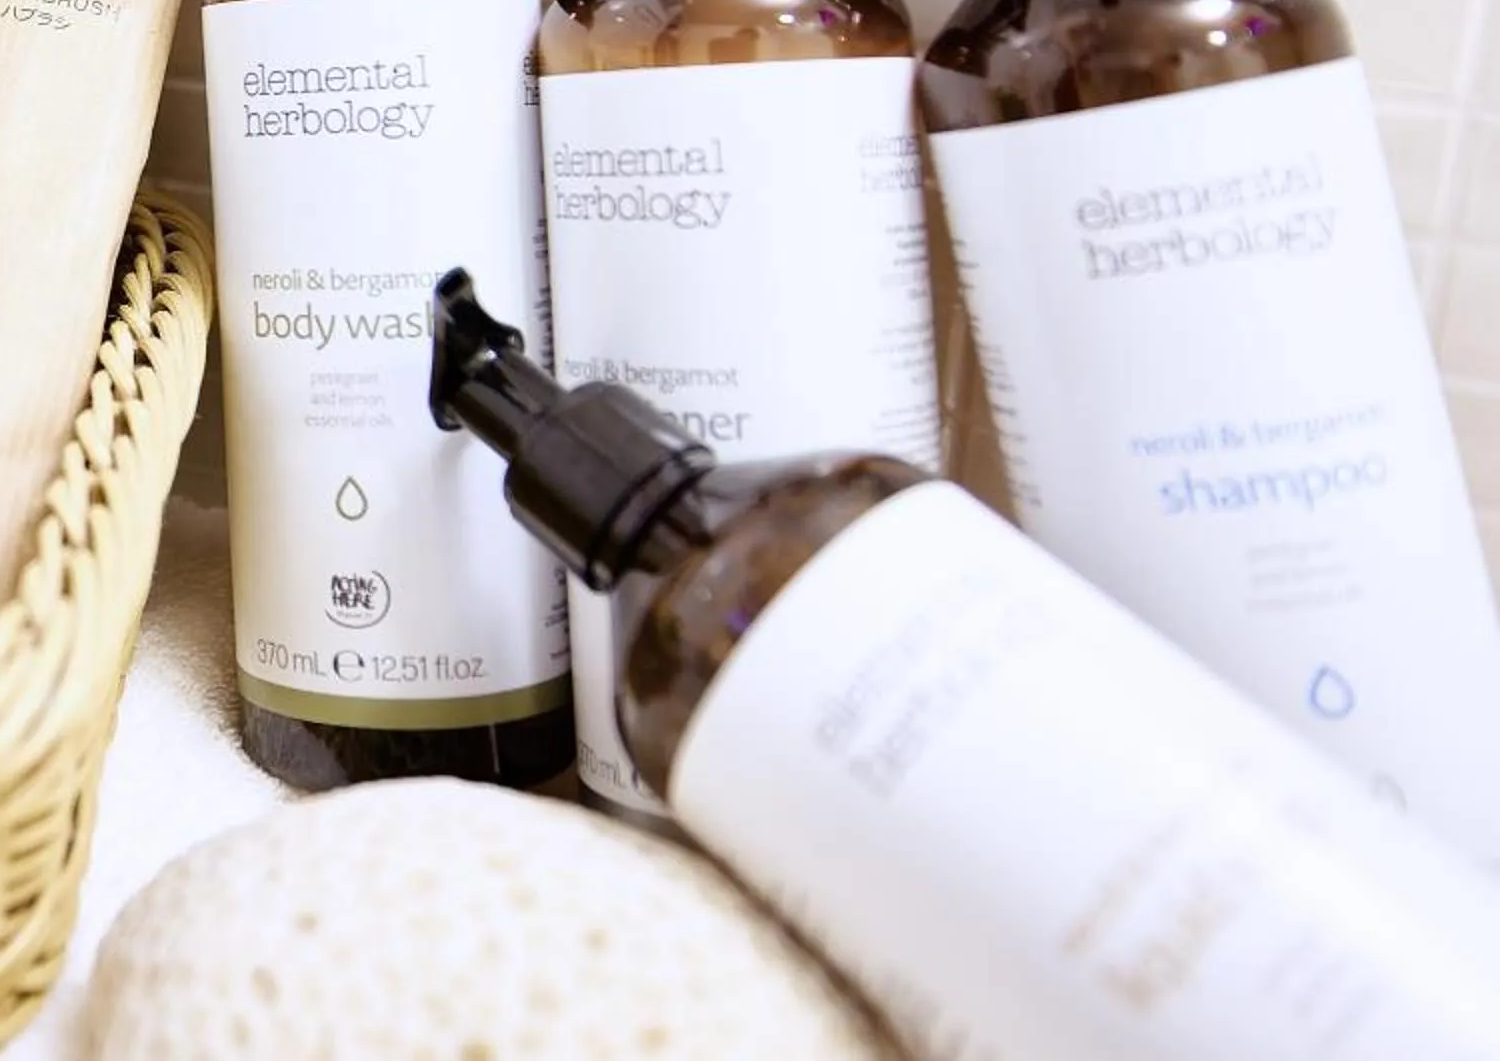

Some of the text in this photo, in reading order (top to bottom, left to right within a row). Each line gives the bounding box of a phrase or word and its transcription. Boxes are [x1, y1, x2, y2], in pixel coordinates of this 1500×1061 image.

[0, 4, 72, 30] ハブラシ
[243, 54, 432, 96] elemental
[243, 100, 435, 140] herbology
[554, 137, 725, 178] elemental
[554, 184, 732, 230] herbology
[1081, 205, 1337, 280] herbology
[252, 269, 303, 290] neroli
[307, 269, 325, 290] &
[254, 300, 335, 351] body
[624, 360, 739, 394] bergamot
[1159, 450, 1388, 516] shampoo
[257, 638, 290, 670] 370
[293, 650, 326, 676] mL
